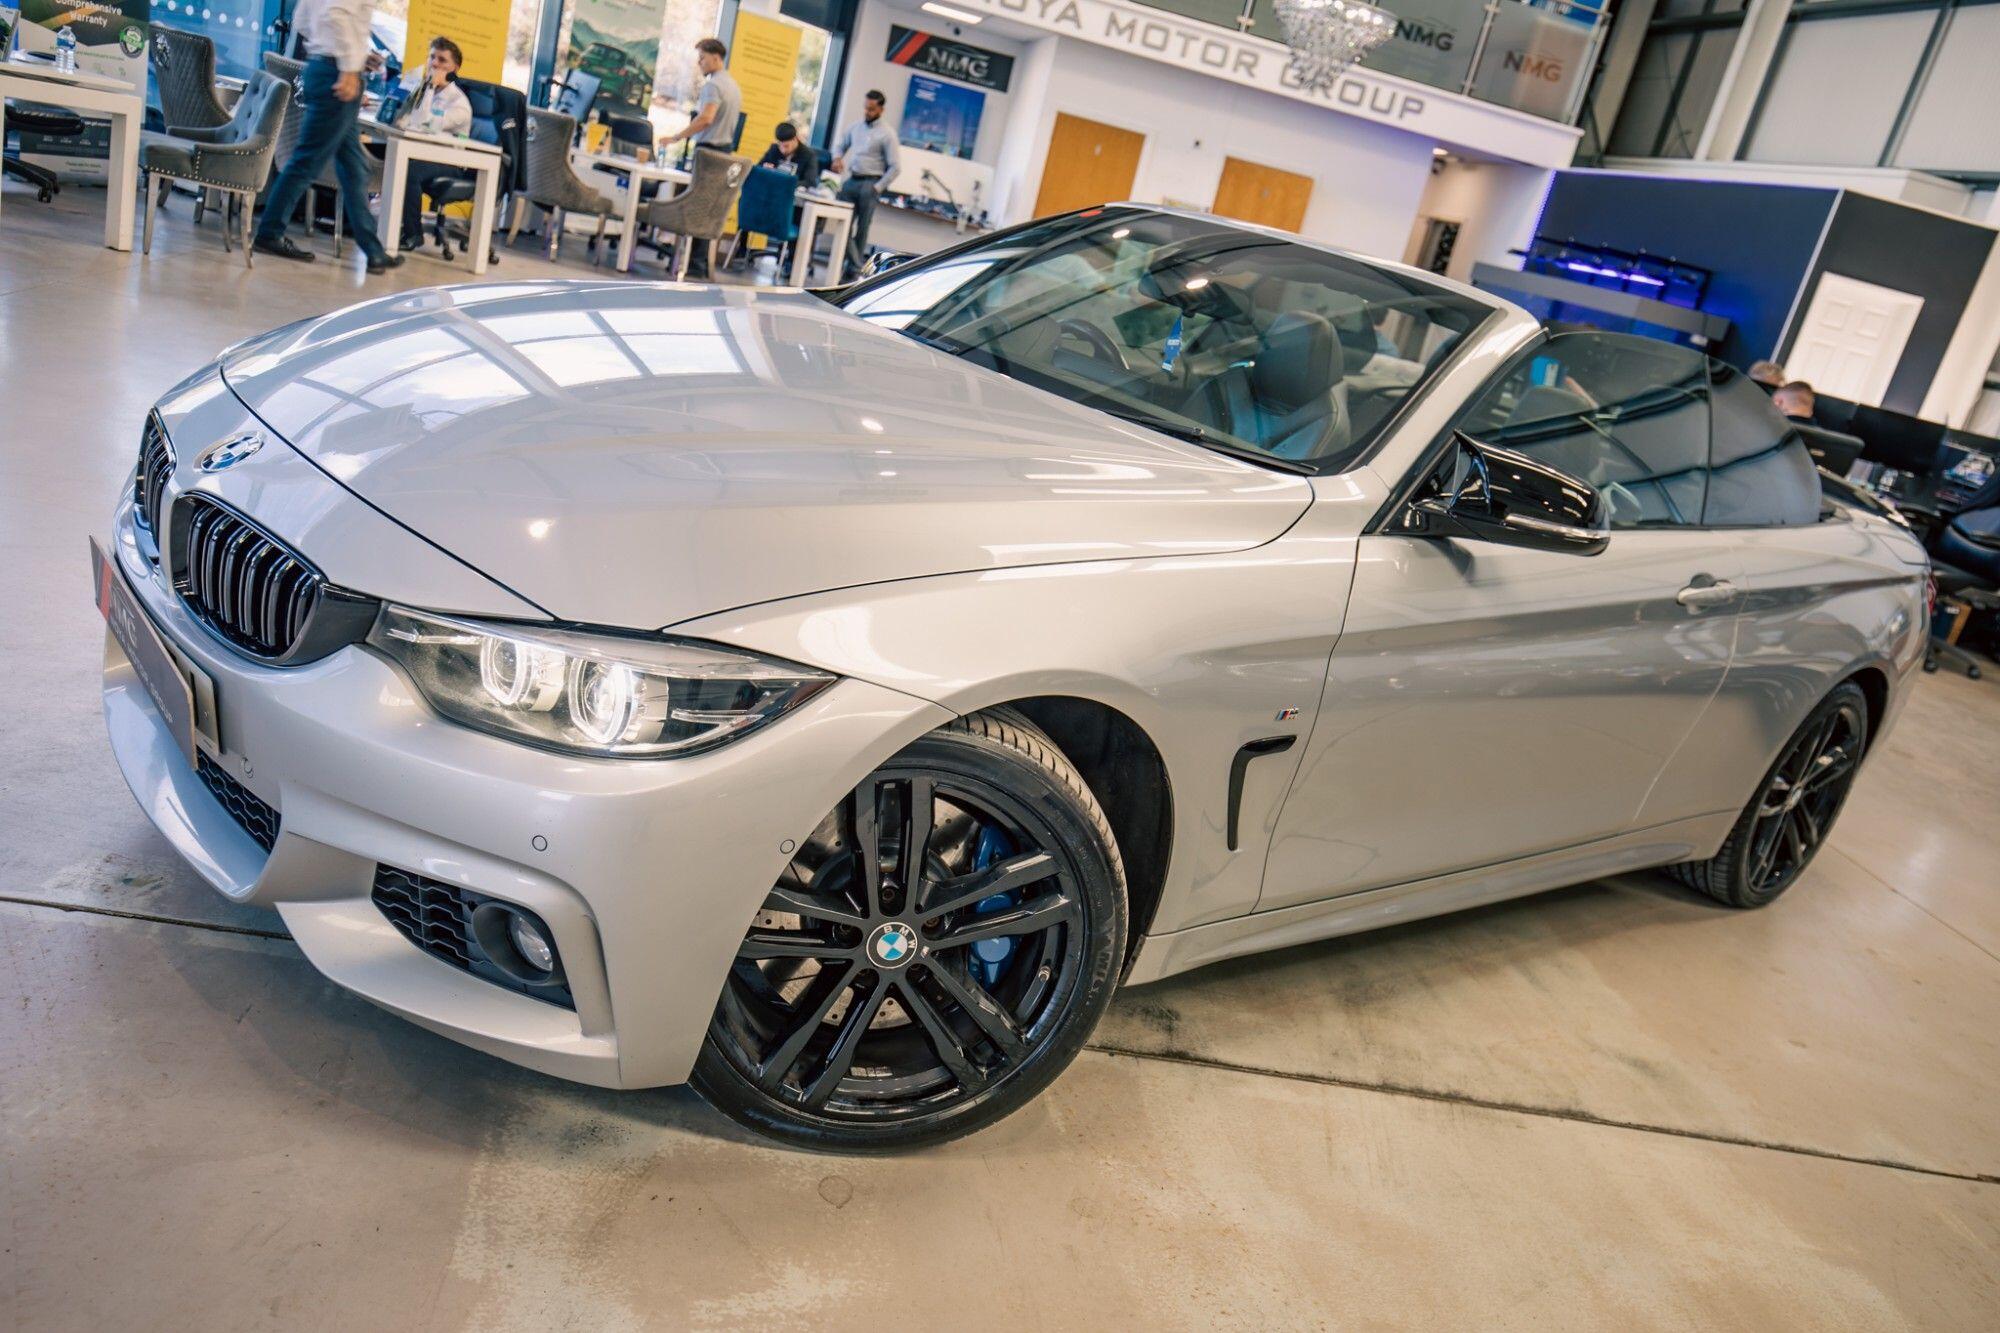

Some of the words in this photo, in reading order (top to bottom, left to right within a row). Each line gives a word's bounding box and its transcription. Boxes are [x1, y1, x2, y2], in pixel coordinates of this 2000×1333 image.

[69, 11, 108, 28] Warranty
[1393, 19, 1456, 51] NMG
[1104, 11, 1260, 77] MOTOR
[926, 46, 990, 78] NMG
[1503, 50, 1564, 82] NMG
[883, 925, 917, 949] BMW
